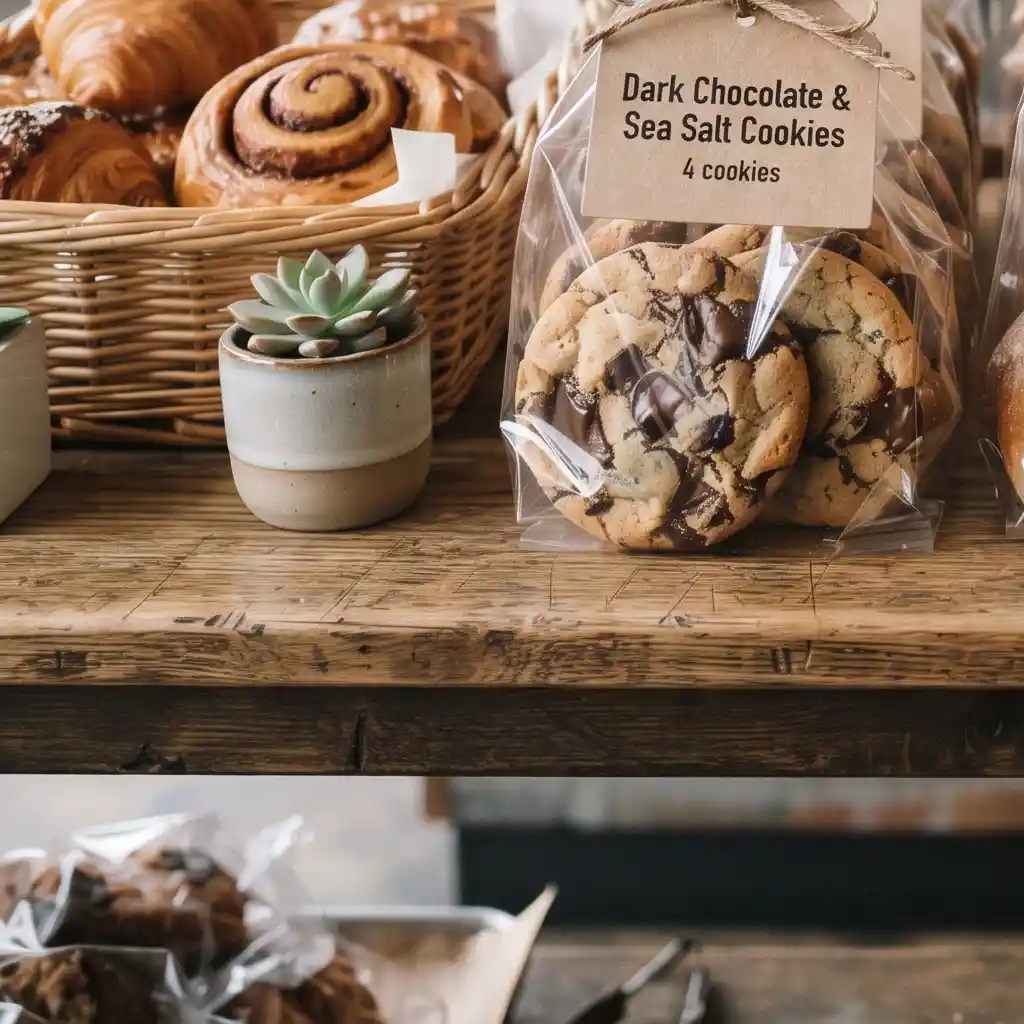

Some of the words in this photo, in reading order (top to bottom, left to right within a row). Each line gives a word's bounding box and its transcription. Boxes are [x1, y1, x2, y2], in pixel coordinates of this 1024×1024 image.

[623, 73, 684, 103] Dark
[693, 76, 822, 108] Chocolate
[832, 84, 850, 111] &
[623, 111, 671, 140] Sea
[681, 113, 732, 143] Salt
[740, 116, 845, 147] Cookies
[683, 158, 694, 179] 4
[702, 160, 780, 182] cookies
